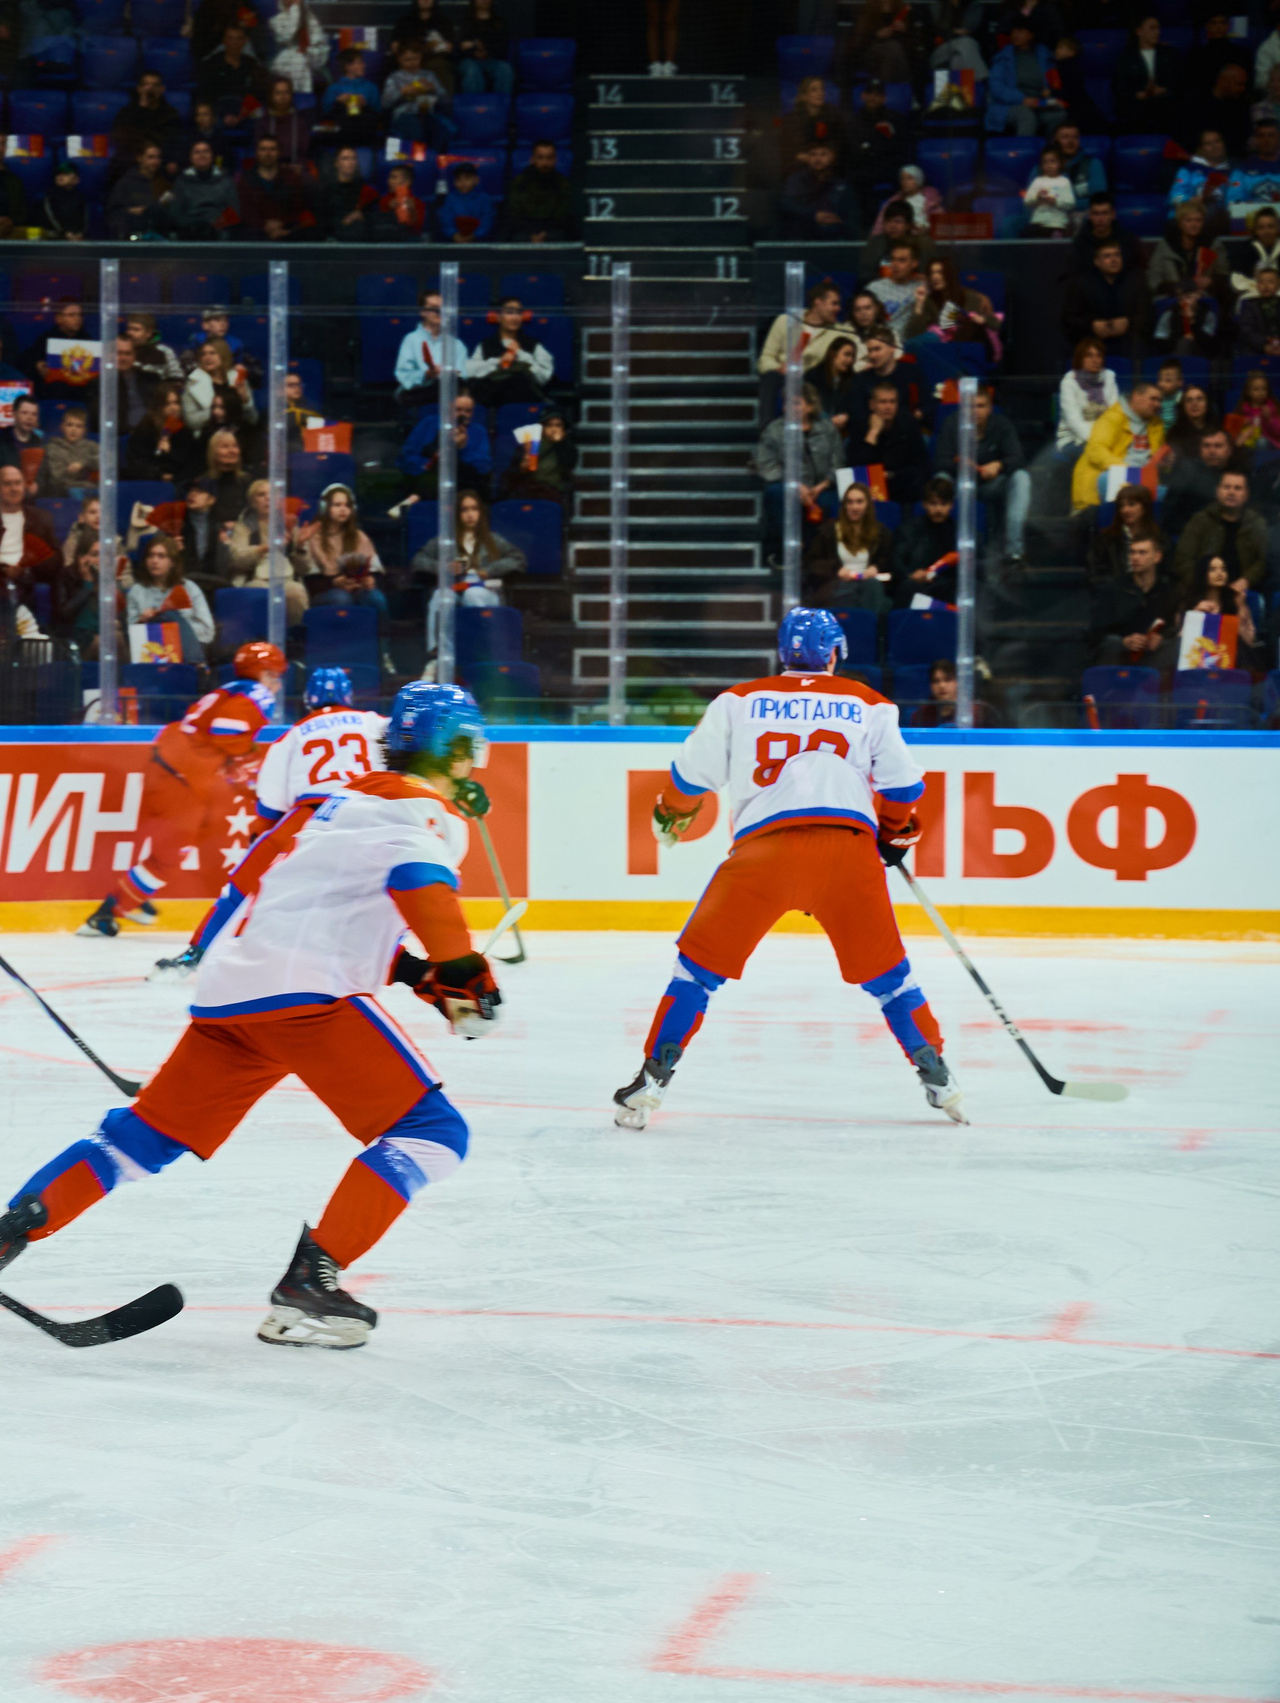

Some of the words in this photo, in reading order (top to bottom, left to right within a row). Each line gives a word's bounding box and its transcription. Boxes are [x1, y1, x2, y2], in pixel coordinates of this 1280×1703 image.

[596, 84, 624, 104] 14
[709, 83, 737, 103] 14
[590, 137, 618, 159] 13
[712, 137, 741, 159] 13
[588, 196, 615, 219] 12
[712, 196, 740, 219] 12
[588, 255, 612, 276] 11
[716, 255, 738, 278] 11
[750, 697, 862, 723] ПРИСТАЛОВ
[302, 733, 373, 785] 23
